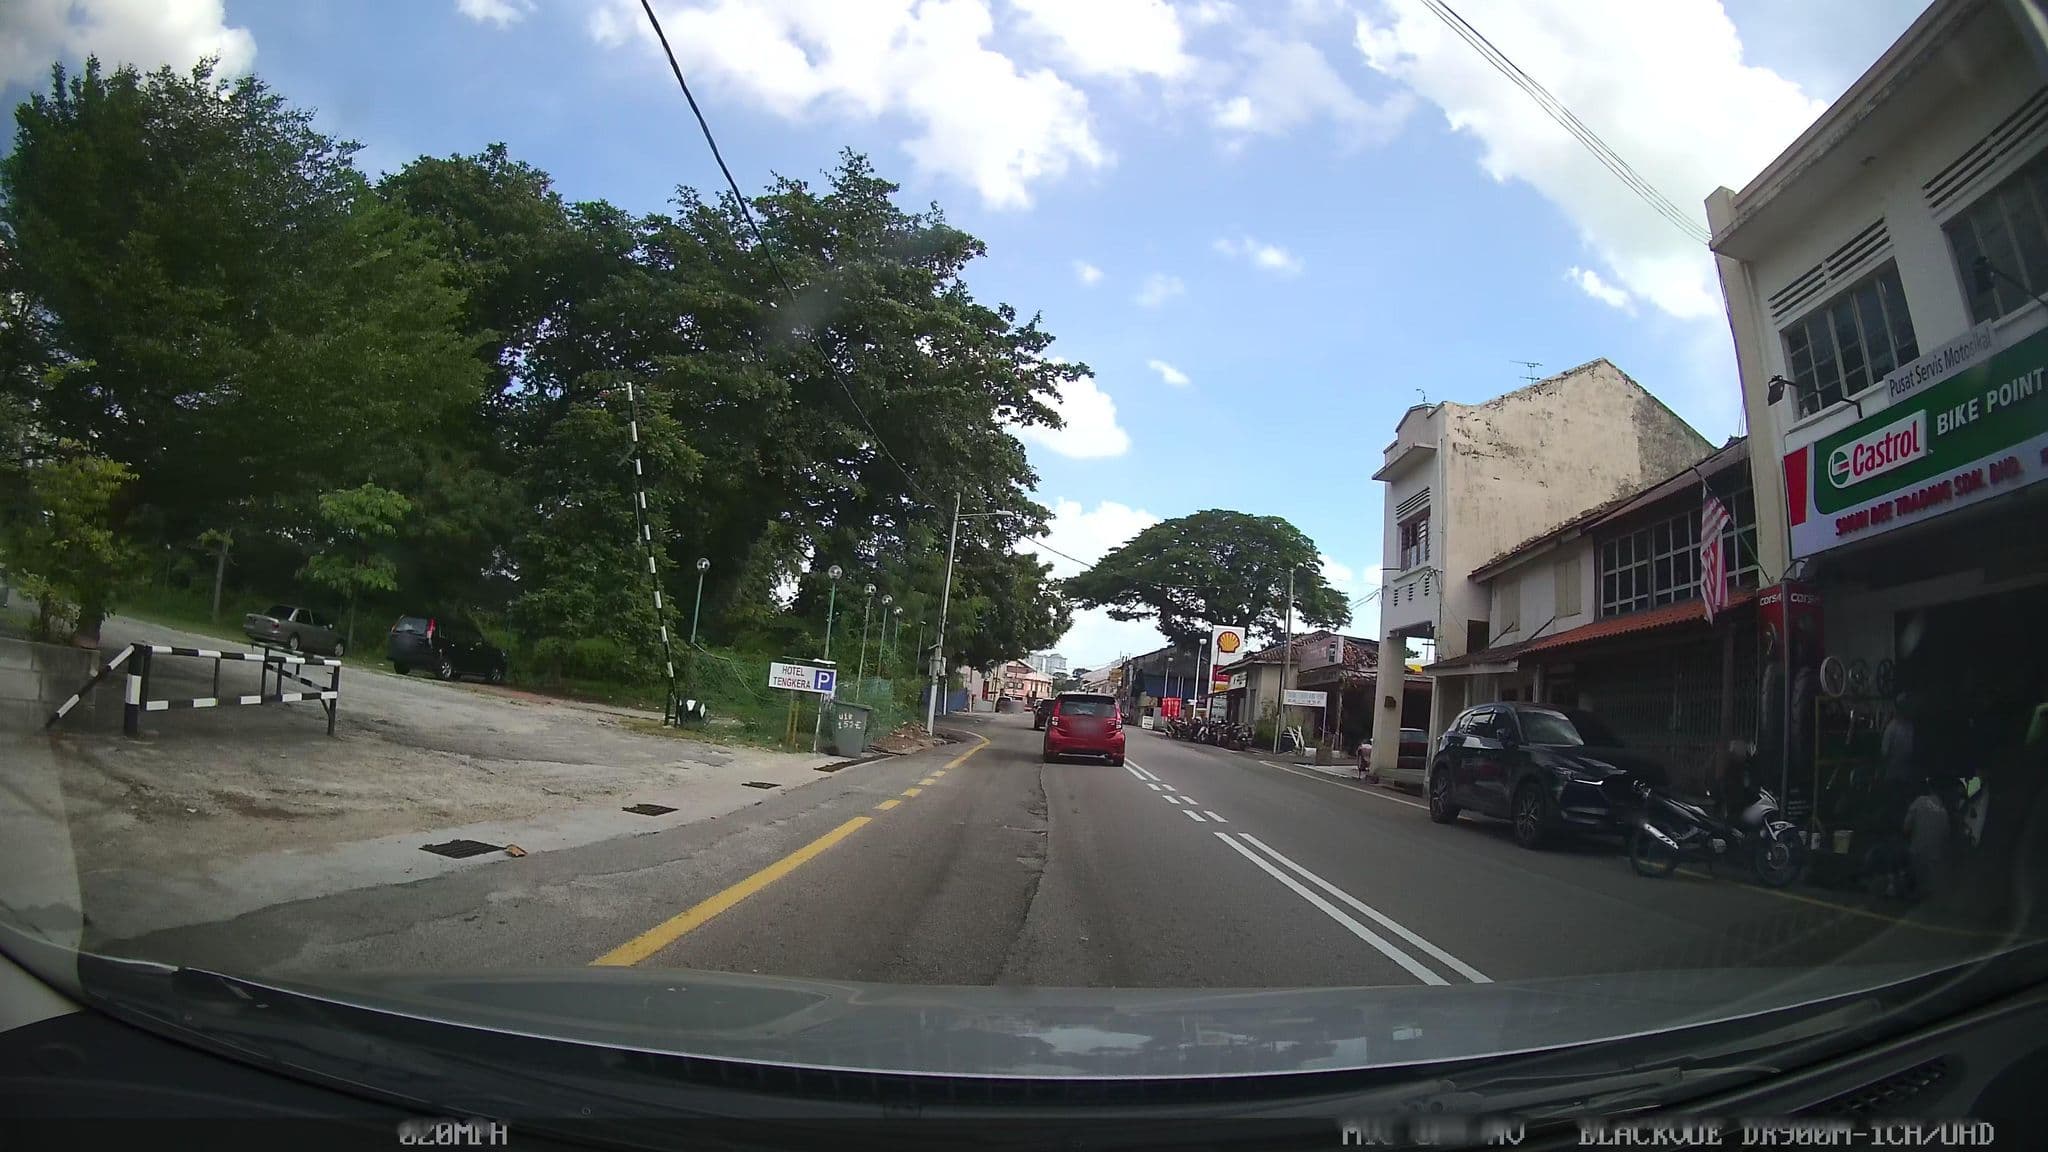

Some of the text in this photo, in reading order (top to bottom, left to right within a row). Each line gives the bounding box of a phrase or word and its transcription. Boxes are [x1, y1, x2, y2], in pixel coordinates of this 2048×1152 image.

[1889, 326, 1992, 397] Pusat Servis Motosikal
[1937, 367, 2044, 436] BIKE POINT
[1852, 420, 1921, 477] Castrol
[773, 676, 811, 689] TENGKERA
[782, 665, 805, 677] HOTEL
[817, 672, 830, 689] P
